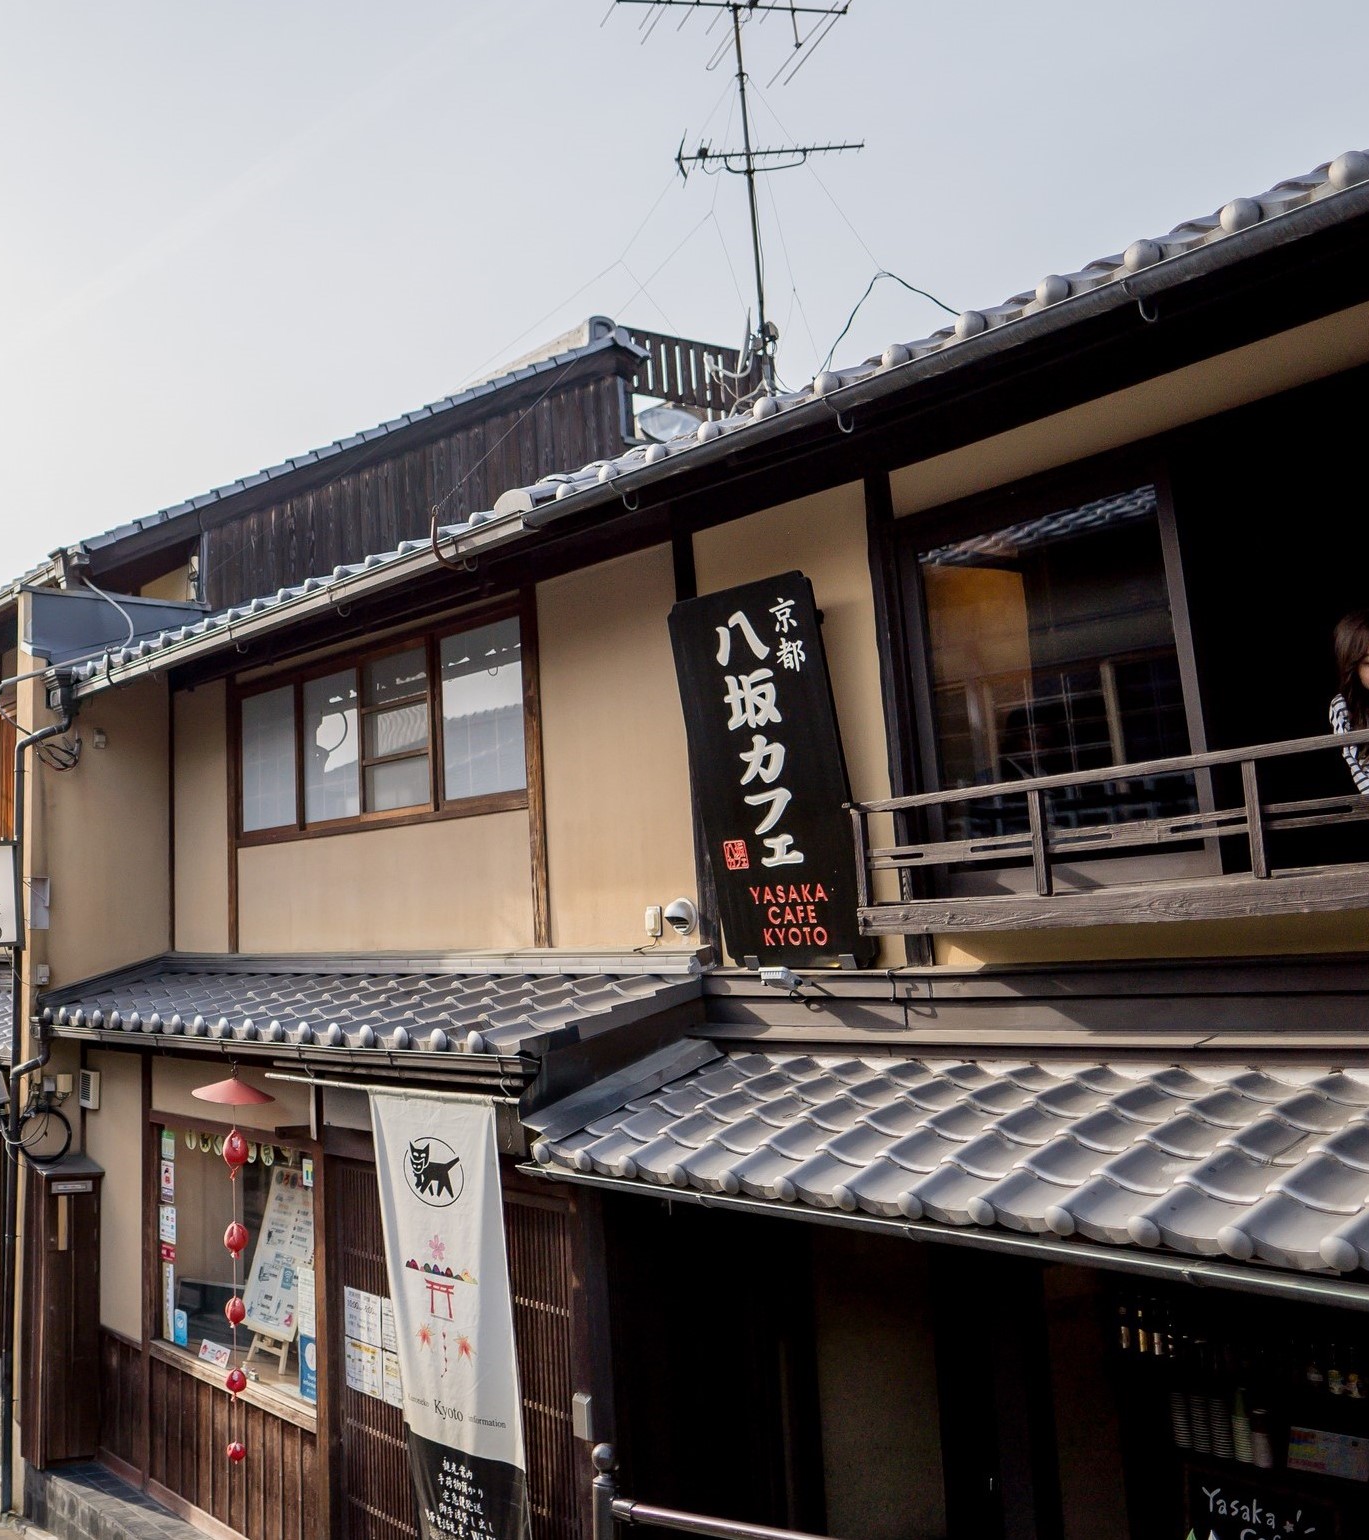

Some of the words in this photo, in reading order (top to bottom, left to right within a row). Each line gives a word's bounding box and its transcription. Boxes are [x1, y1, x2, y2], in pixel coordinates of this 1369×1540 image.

[768, 596, 806, 673] 京都
[715, 609, 804, 869] 八坂カフェ
[749, 883, 829, 905] YASAKA
[767, 904, 818, 925] CAFE
[762, 926, 828, 947] KYOTO
[433, 1399, 464, 1422] Kyoto
[1201, 1486, 1276, 1530] Yasaka
